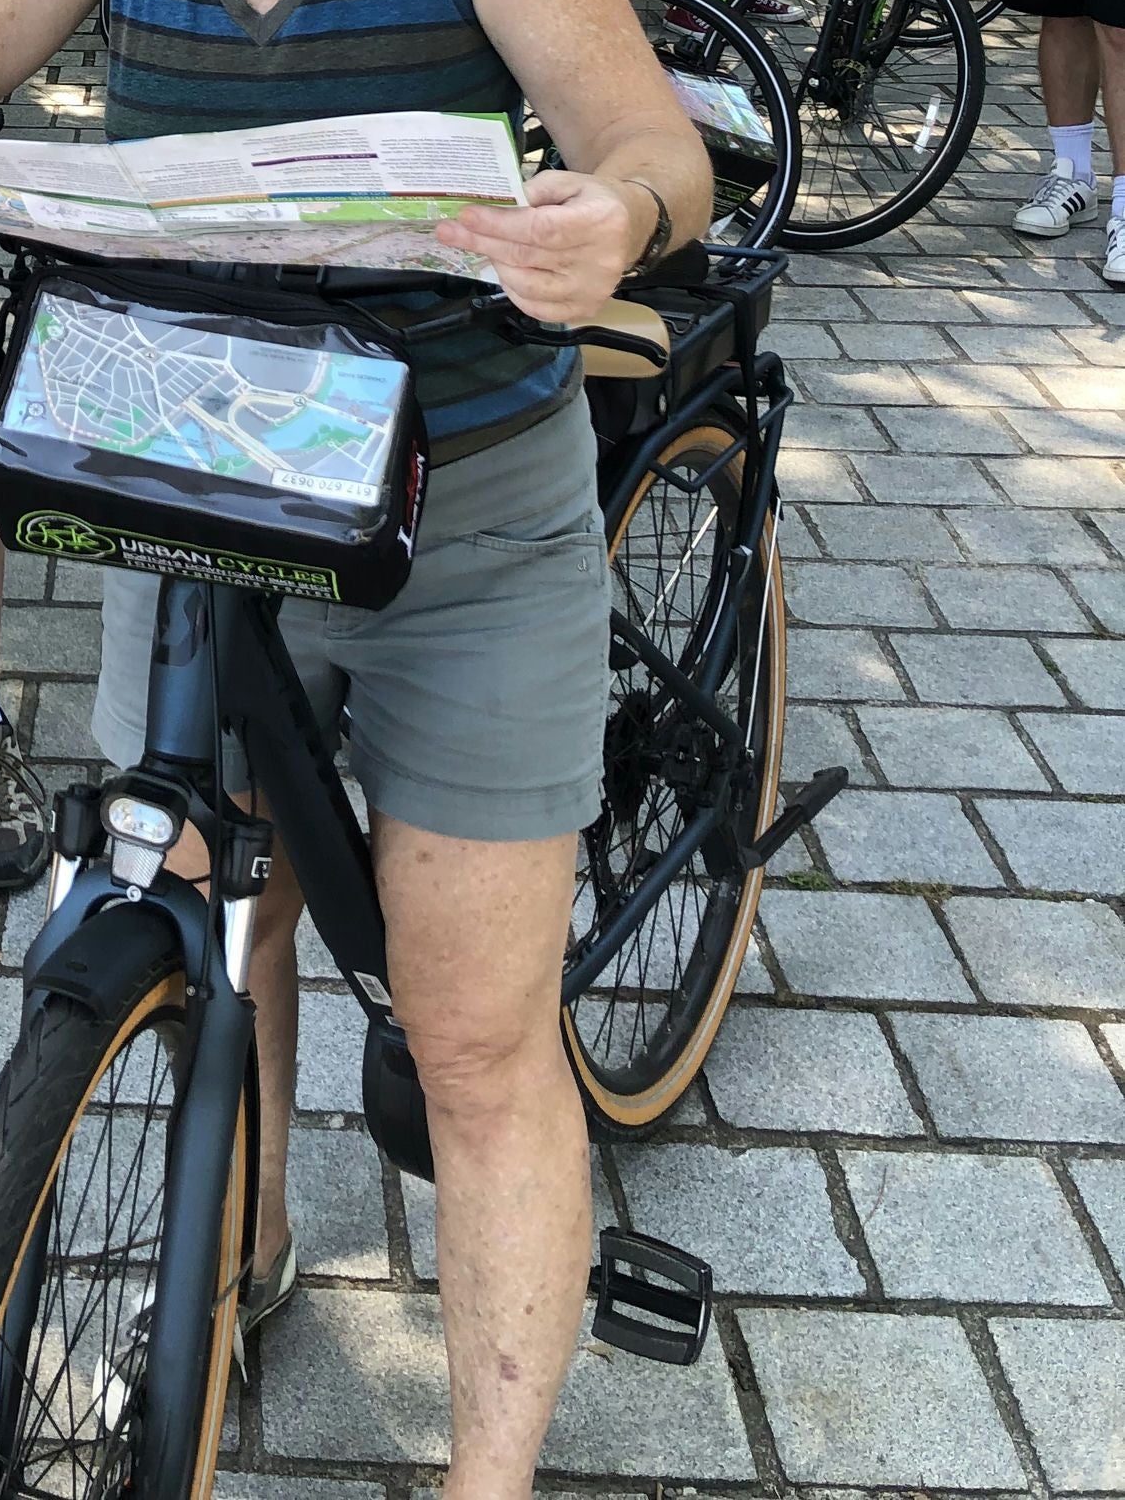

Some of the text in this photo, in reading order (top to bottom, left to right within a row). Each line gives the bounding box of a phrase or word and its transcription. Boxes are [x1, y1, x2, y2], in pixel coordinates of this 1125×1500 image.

[282, 473, 372, 497] 617 670 0637
[120, 537, 328, 584] URBAN CYCLES
